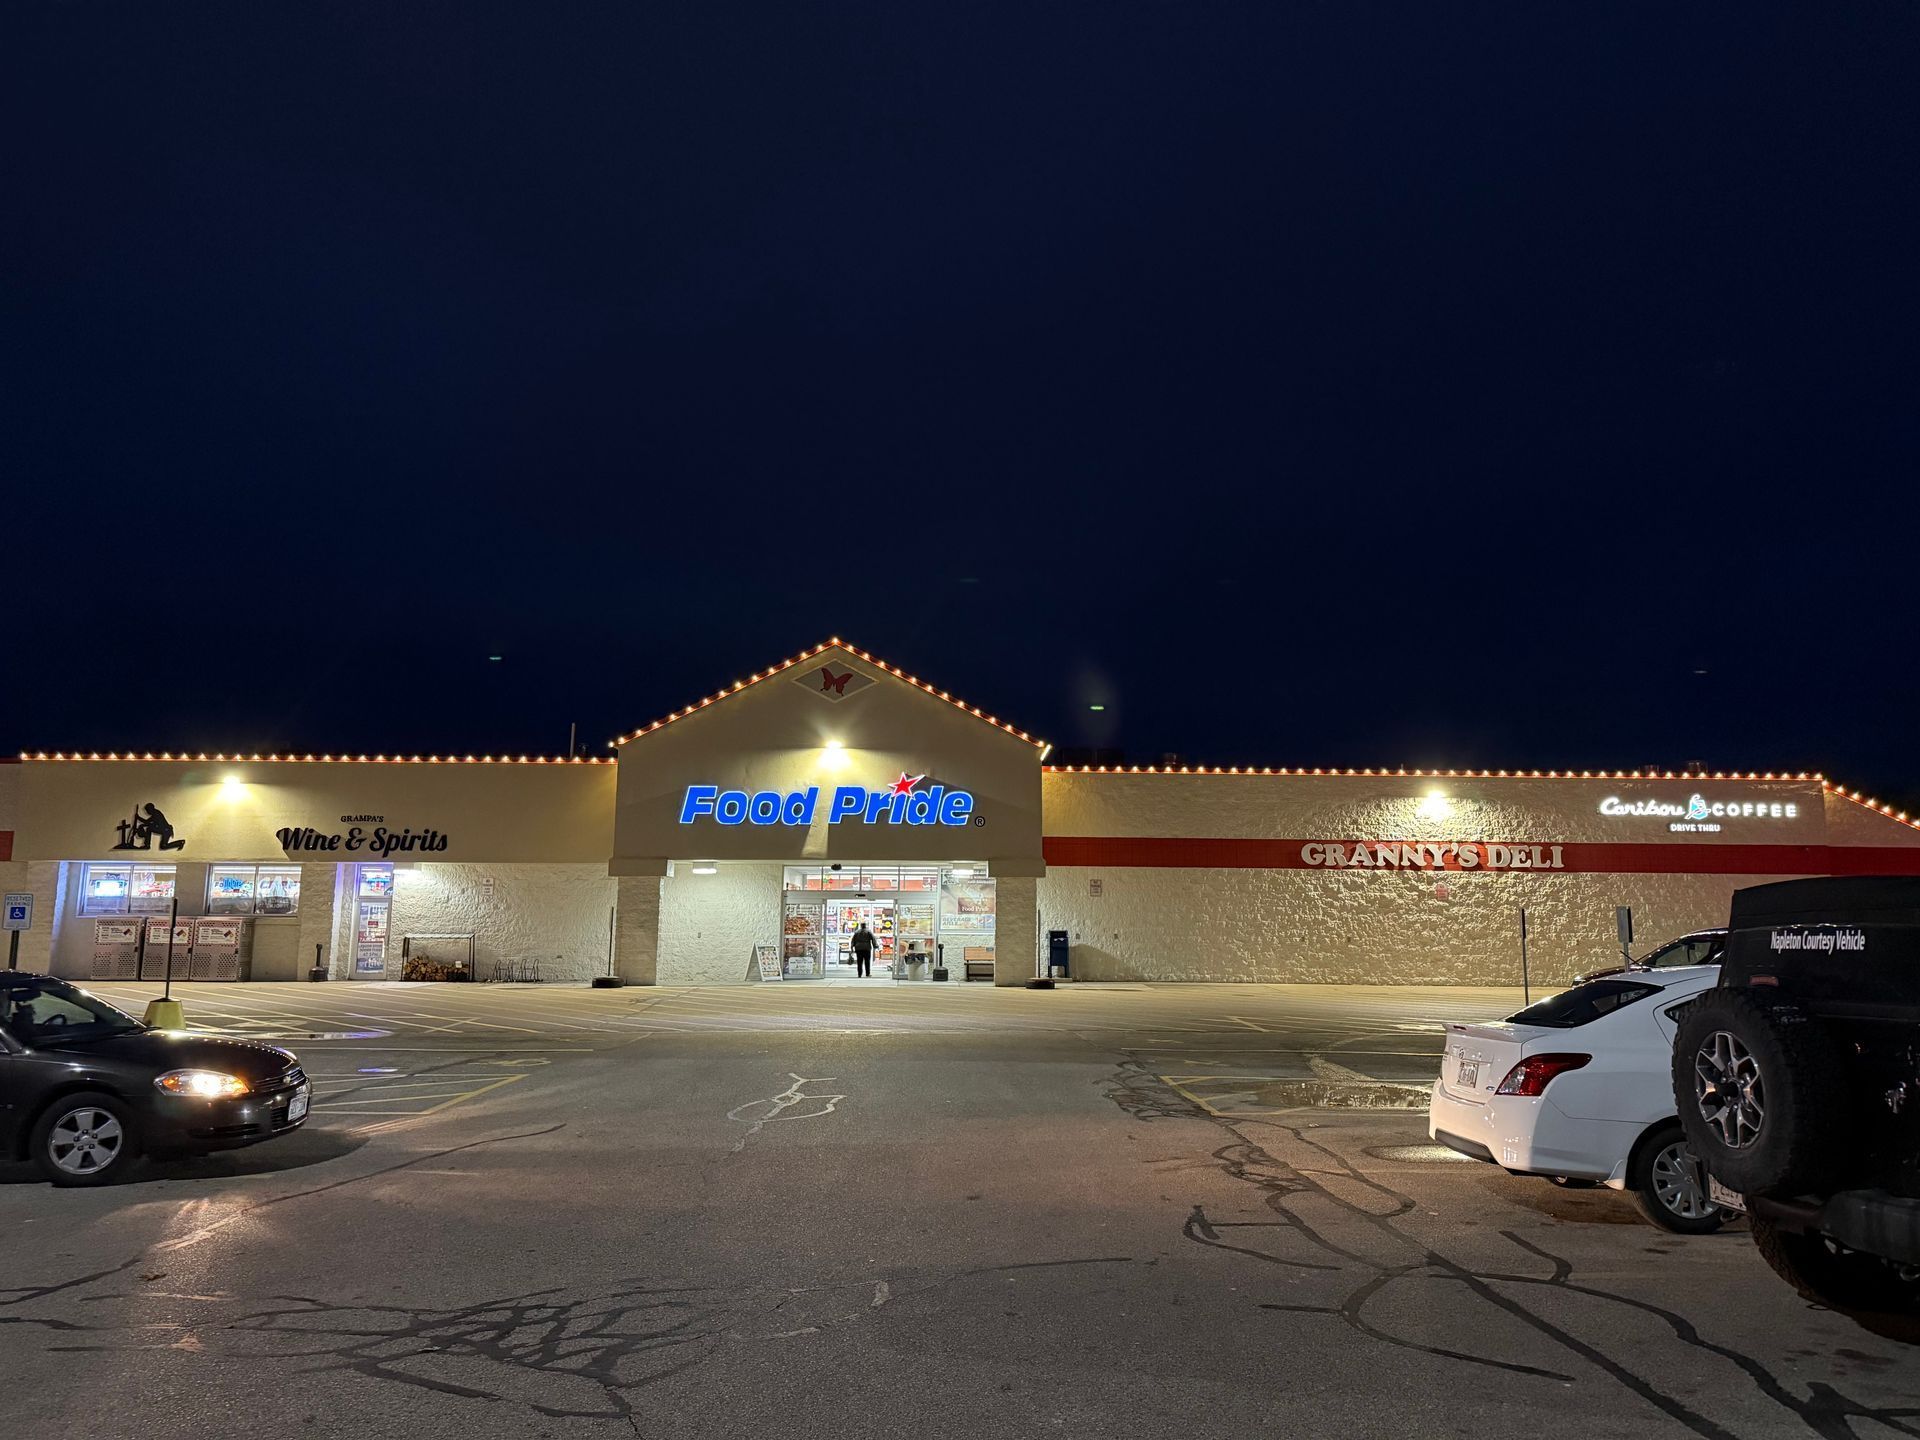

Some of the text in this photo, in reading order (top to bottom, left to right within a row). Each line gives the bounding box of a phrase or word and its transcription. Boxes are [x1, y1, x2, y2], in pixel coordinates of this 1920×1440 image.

[680, 785, 819, 826] Food
[828, 779, 974, 826] Pride
[1600, 797, 1798, 817] Caribou COFFEE
[340, 815, 385, 823] GRAMPA'S
[1670, 823, 1721, 832] DRIVE THRU
[276, 827, 448, 858] Wine & Spirits
[1301, 842, 1565, 869] GRANNY'S DELI
[1771, 930, 1866, 955] Napleton Courtesy Vehicle
